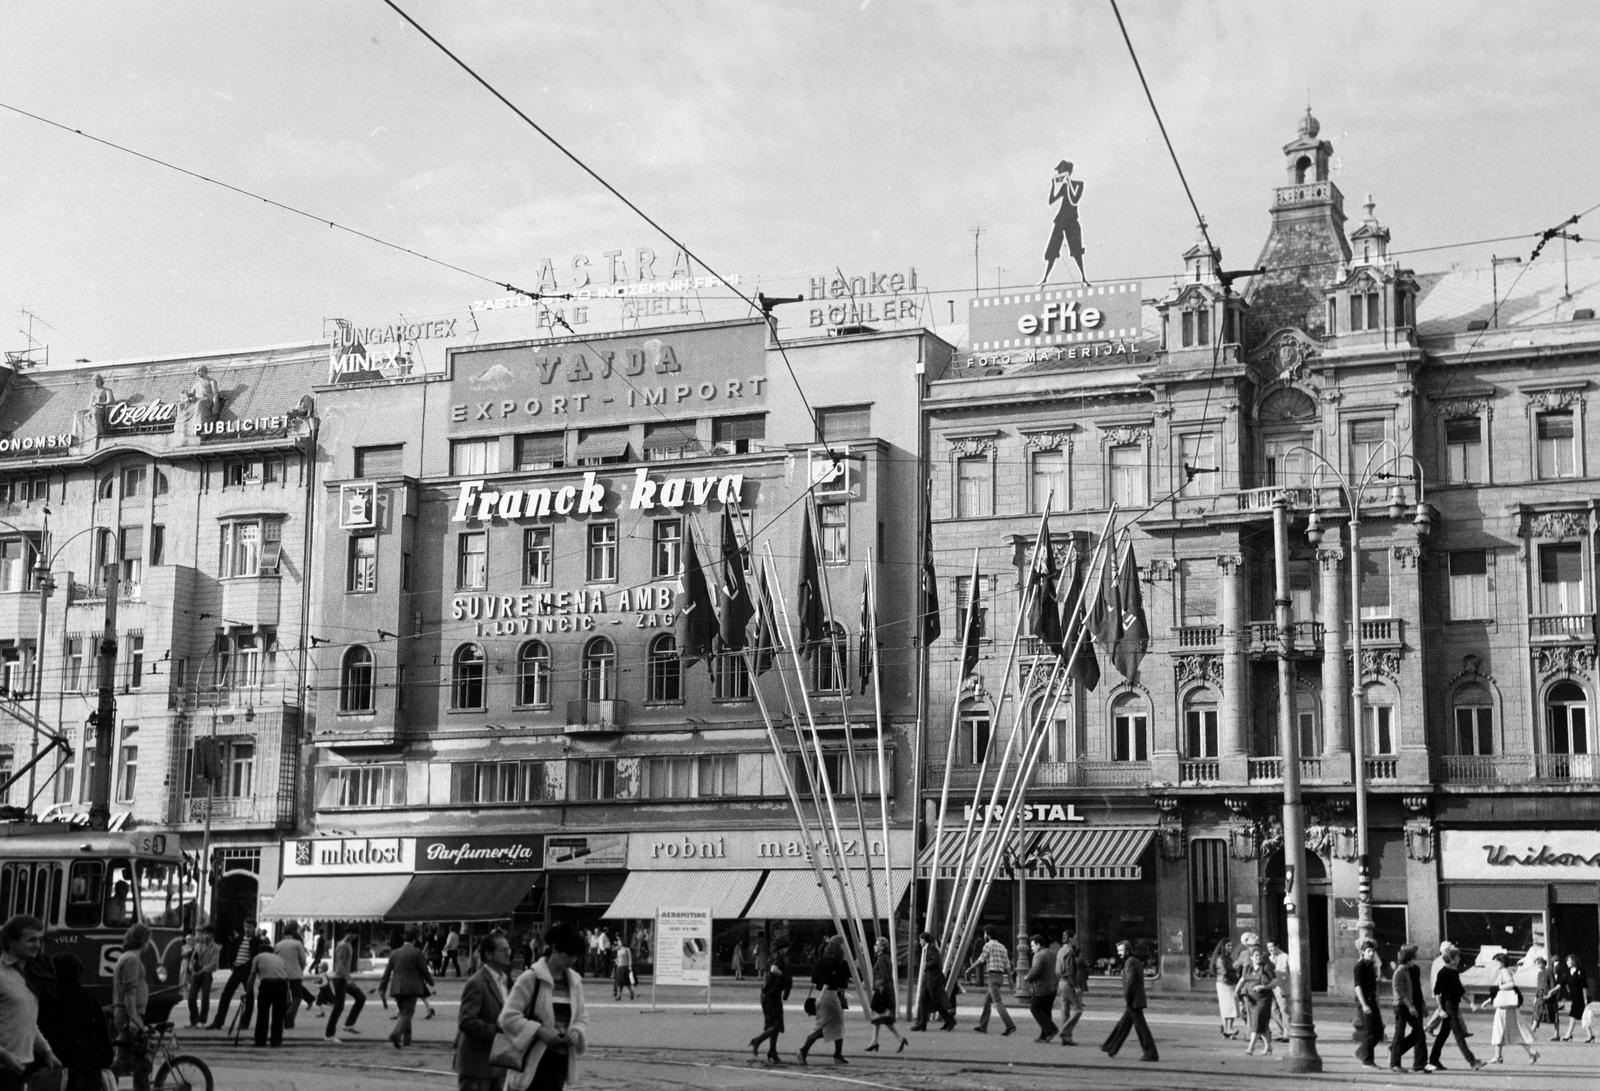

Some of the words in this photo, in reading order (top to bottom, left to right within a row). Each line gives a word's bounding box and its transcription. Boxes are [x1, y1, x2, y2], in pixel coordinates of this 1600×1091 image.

[536, 247, 692, 294] ASTRA
[809, 267, 918, 301] Henkel
[333, 319, 457, 347] HUNGAROTEX
[329, 346, 401, 374] MINEX
[536, 345, 682, 384] VAJDA
[967, 356, 1011, 368] FOTO
[1025, 343, 1139, 363] MATERIJAL
[451, 393, 590, 422] EXPORT
[627, 376, 767, 408] IMPORT
[194, 415, 289, 435] PUBLICITET
[452, 471, 605, 522] Franck
[629, 468, 744, 510] kava
[453, 588, 606, 620] SUVREMENA
[963, 804, 1085, 821] KRSTAL
[321, 839, 403, 865] mladost
[426, 843, 533, 865] Parfumerija
[651, 837, 725, 858] robni
